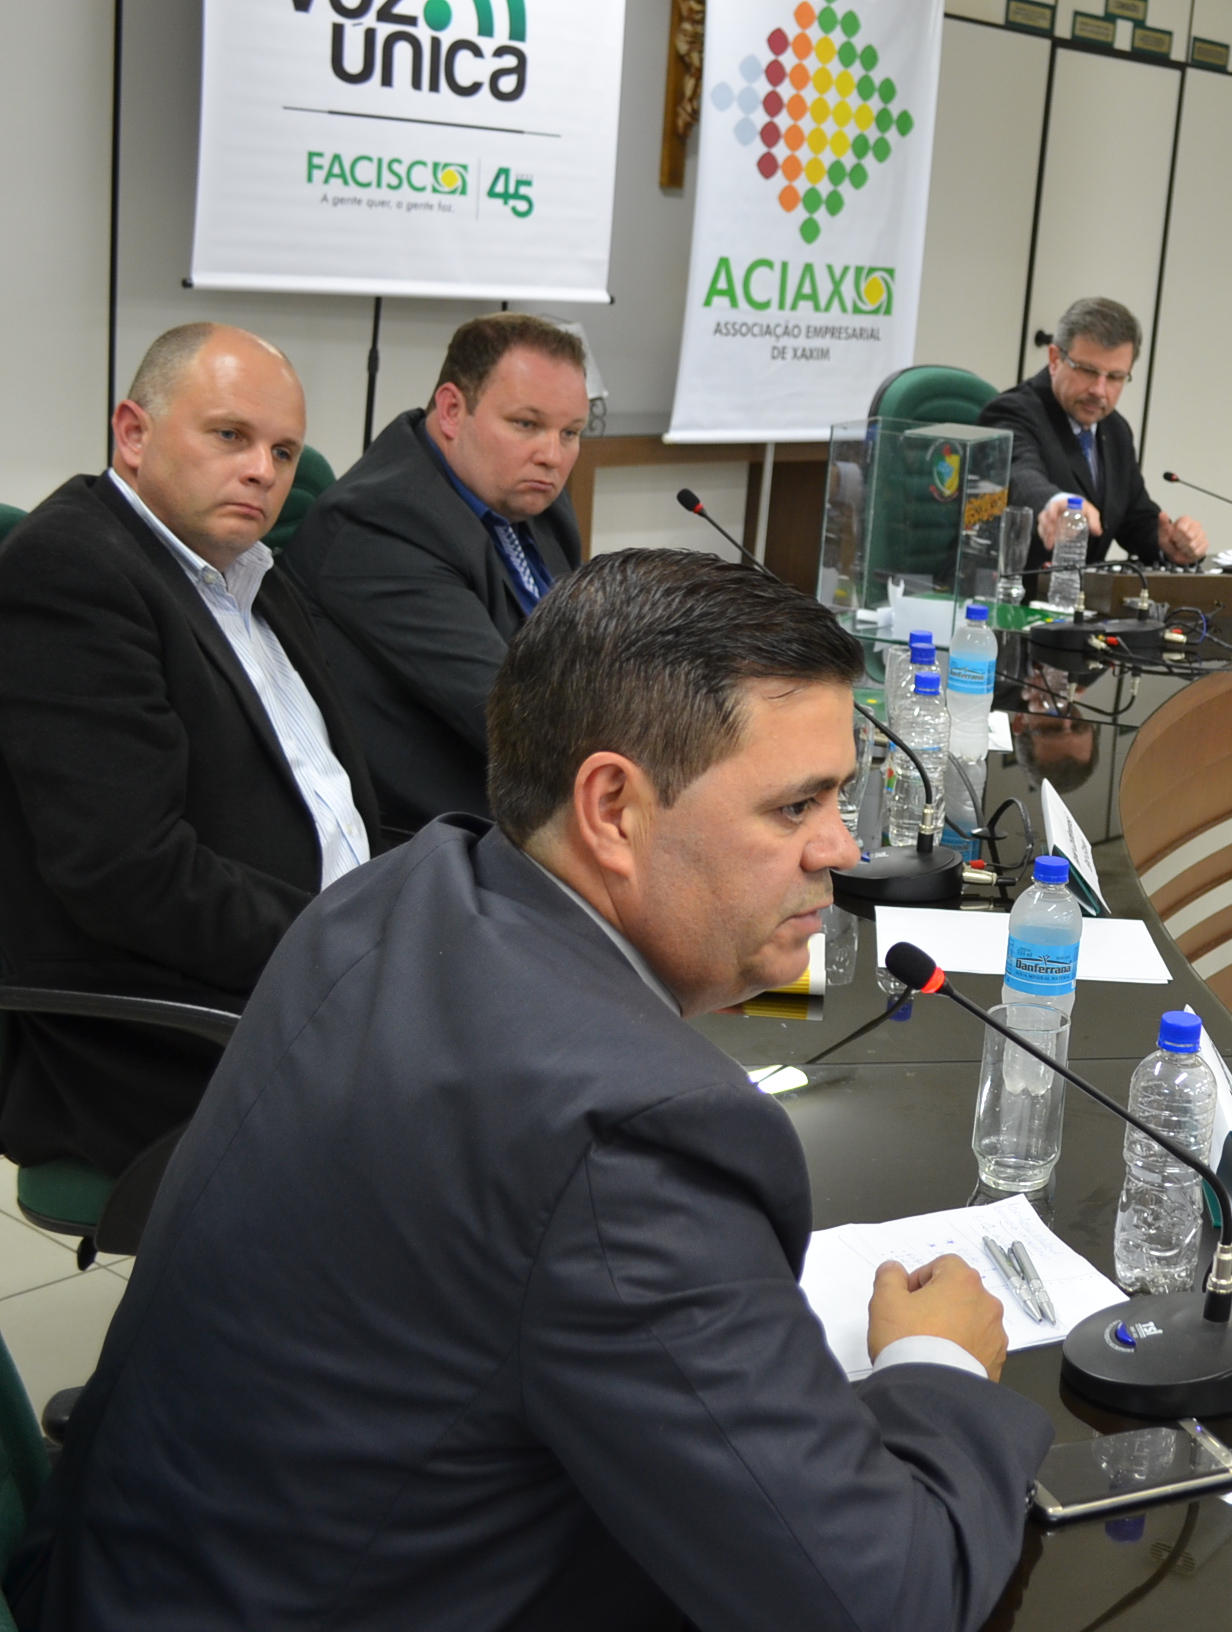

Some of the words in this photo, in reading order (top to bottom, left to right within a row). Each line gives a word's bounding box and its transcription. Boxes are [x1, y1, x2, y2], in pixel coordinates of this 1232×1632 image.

[307, 151, 428, 193] FACISC
[487, 166, 534, 219] 45
[332, 195, 363, 209] gente
[406, 202, 435, 213] gente
[703, 256, 851, 313] ACIAX
[714, 320, 802, 342] ASSOCIAÇÃO
[805, 325, 881, 341] EMPRESARIAL
[771, 346, 787, 360] DE
[791, 348, 831, 361] XAXIM
[1015, 960, 1071, 974] Danferrana
